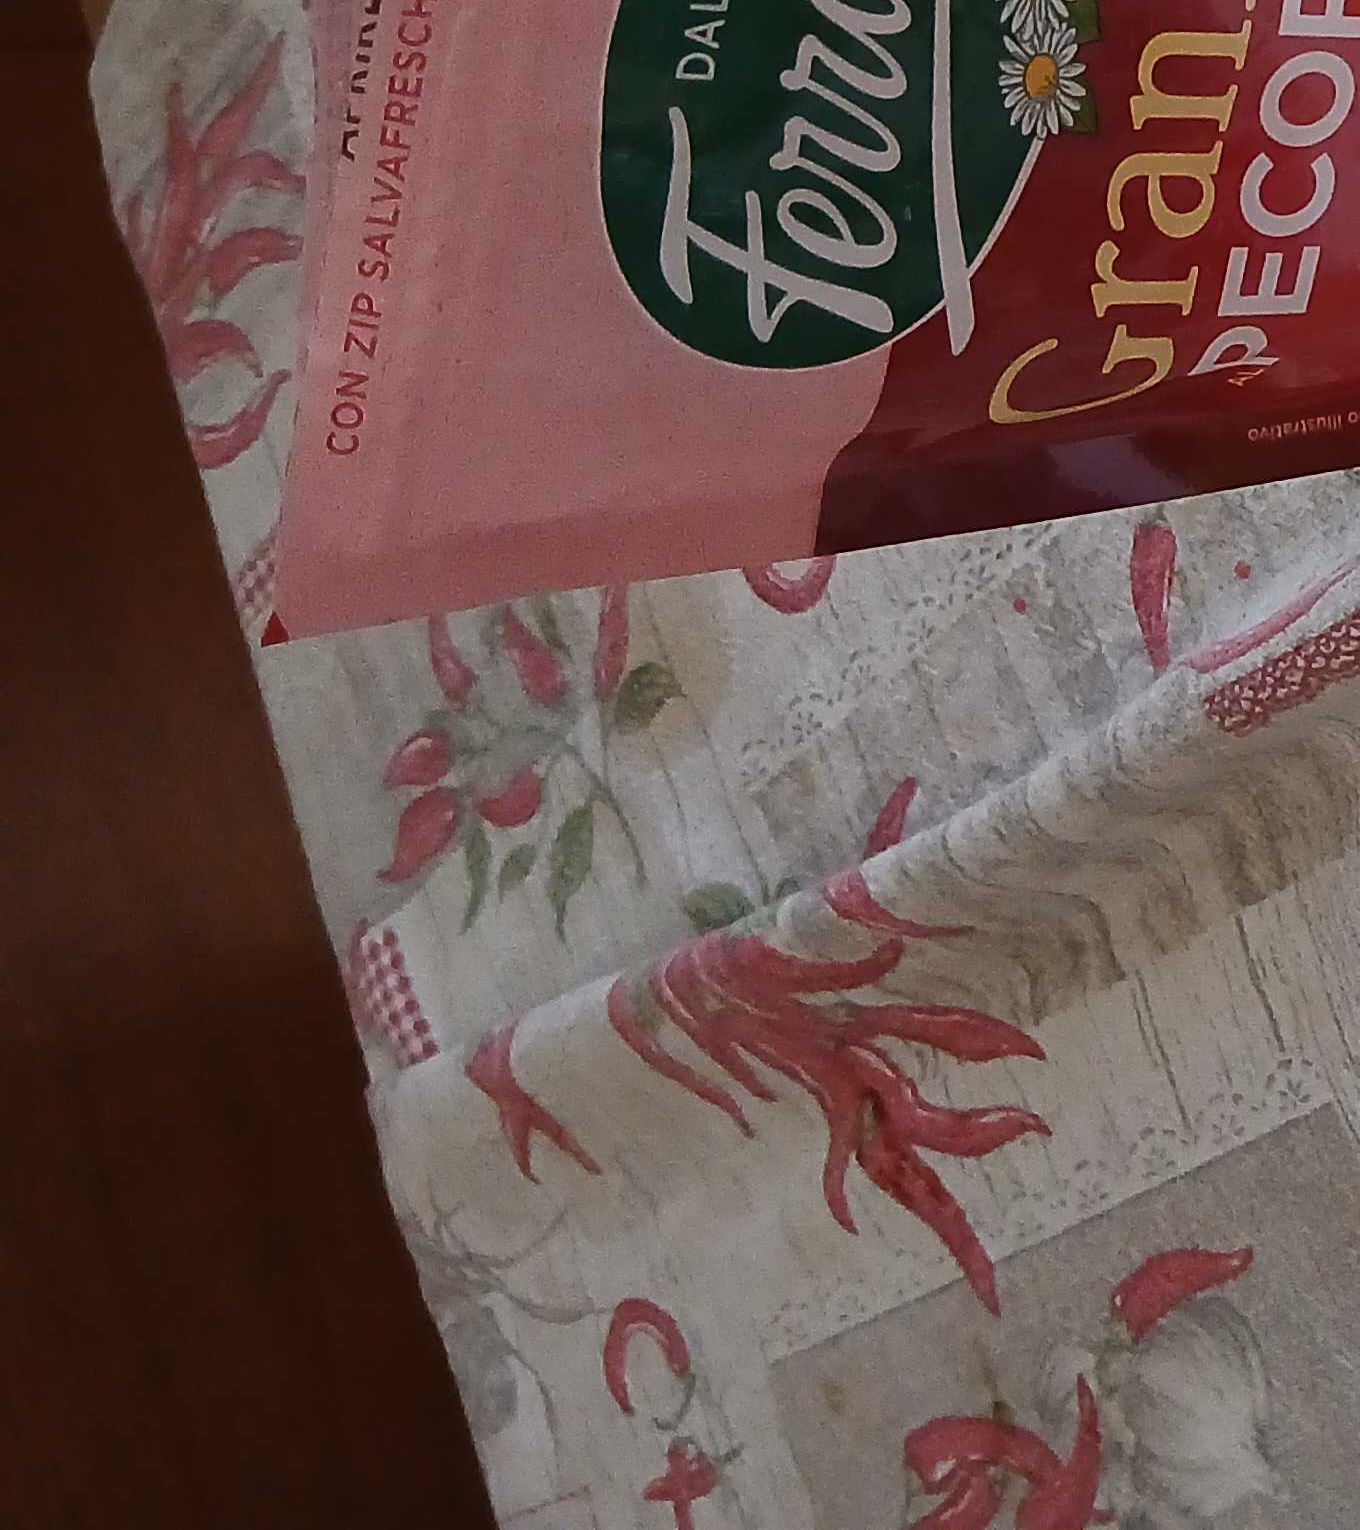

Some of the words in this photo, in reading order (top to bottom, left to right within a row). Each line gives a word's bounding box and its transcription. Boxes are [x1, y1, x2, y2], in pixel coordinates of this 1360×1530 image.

[342, 291, 383, 360] ZIP
[325, 370, 371, 456] CON
[1247, 412, 1343, 443] illustrativo
